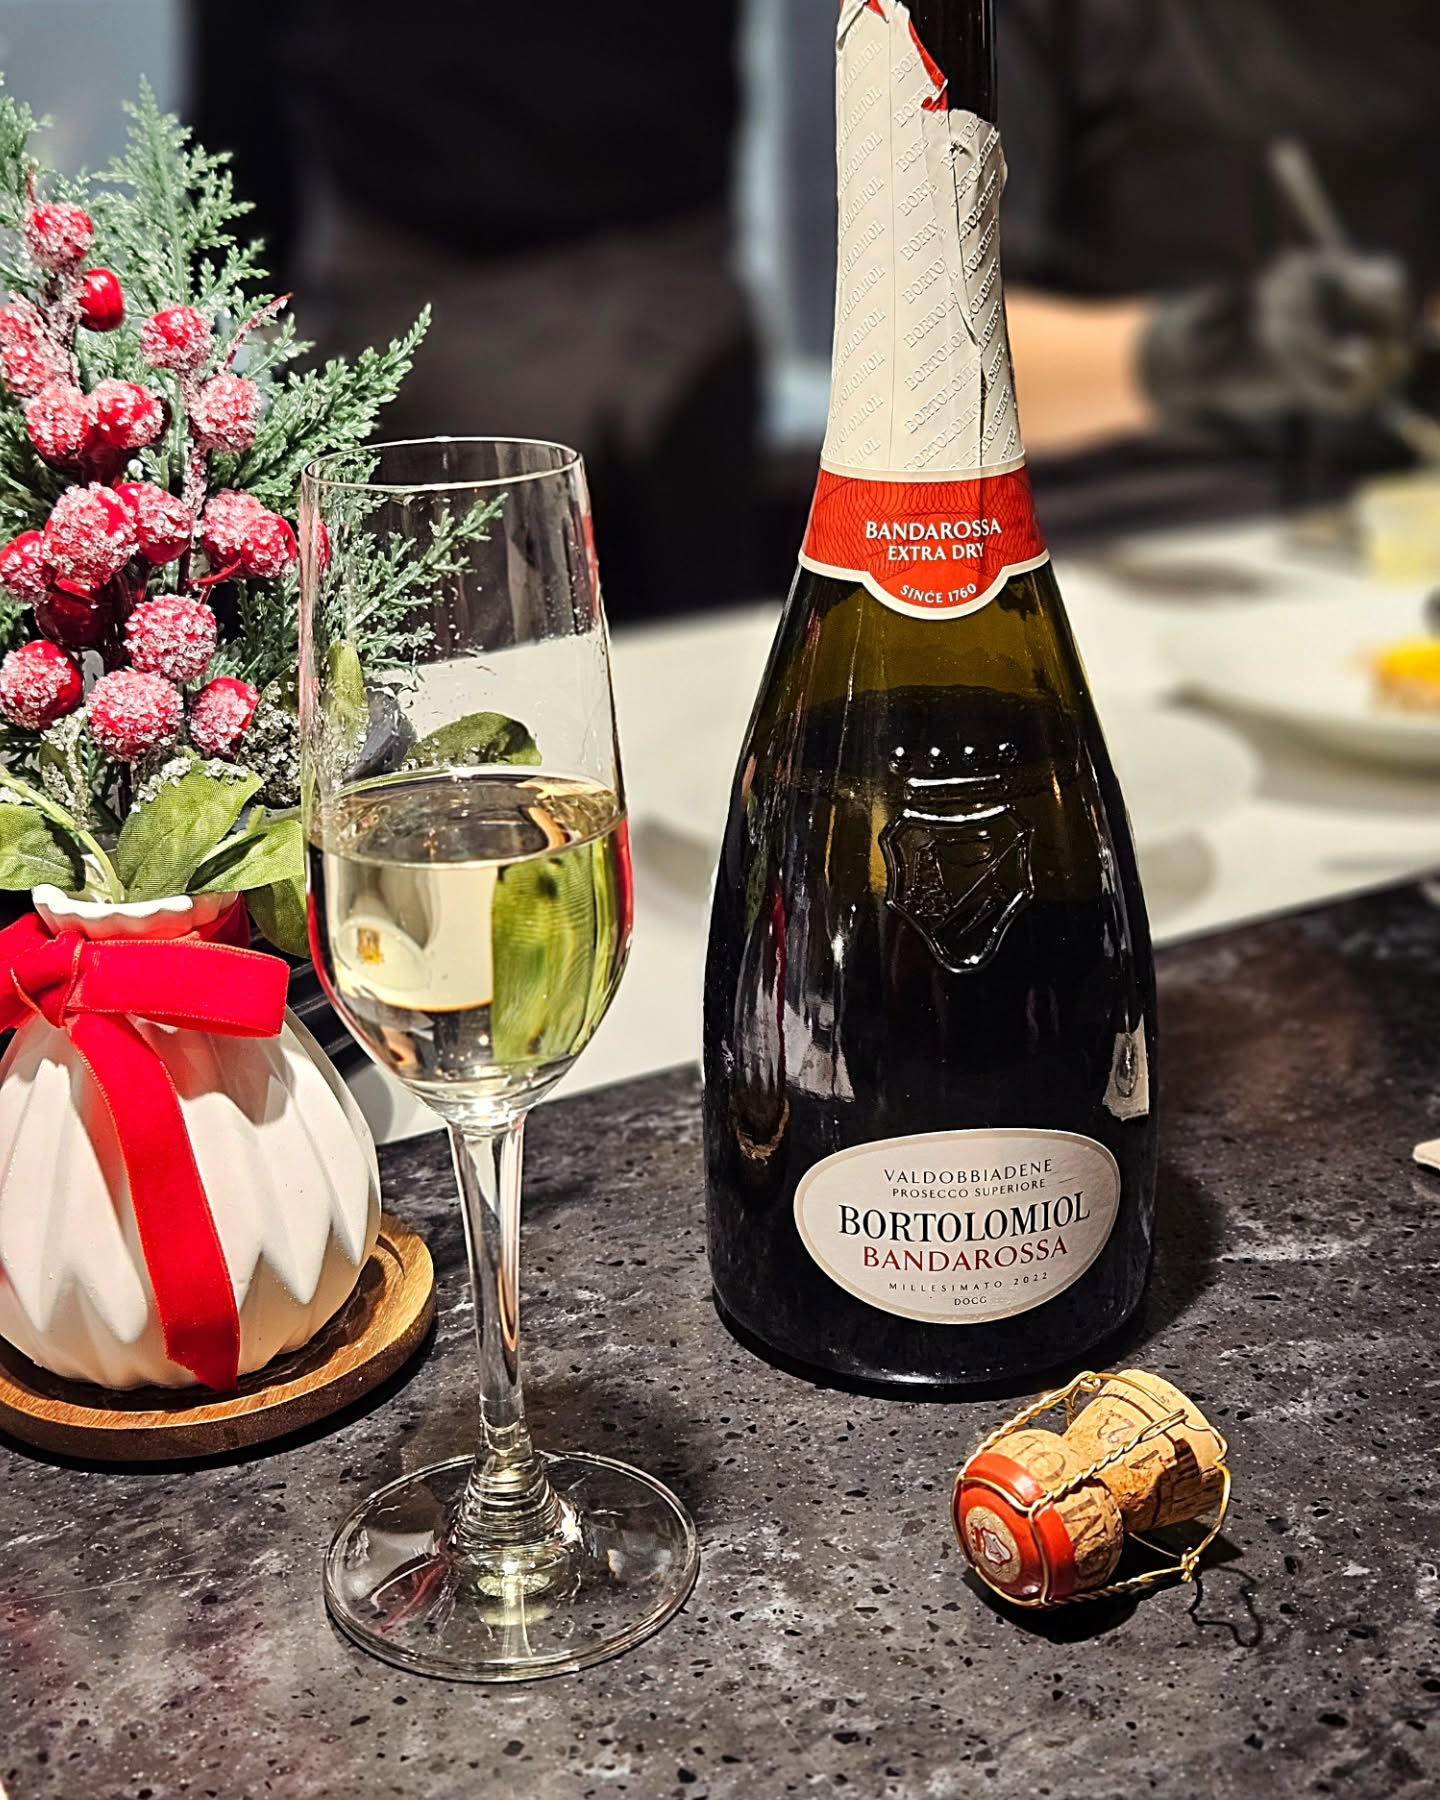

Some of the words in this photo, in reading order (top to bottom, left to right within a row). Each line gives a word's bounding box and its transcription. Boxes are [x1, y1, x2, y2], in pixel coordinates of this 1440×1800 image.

[865, 517, 1002, 541] BANDAROSSA
[887, 541, 946, 562] EXTRA
[951, 541, 985, 560] DRY
[899, 583, 944, 604] SINCE
[948, 583, 978, 603] 1760
[884, 1158, 1053, 1185] VALDOBBIADENE
[892, 1185, 969, 1199] PROSECCO
[974, 1178, 1046, 1198] SUPERIORE
[838, 1190, 1091, 1243] BORTOLOMIOL
[863, 1235, 1069, 1273] BANDAROSSA
[888, 1280, 1004, 1292] MILLESIMATO
[1013, 1271, 1049, 1286] 2022
